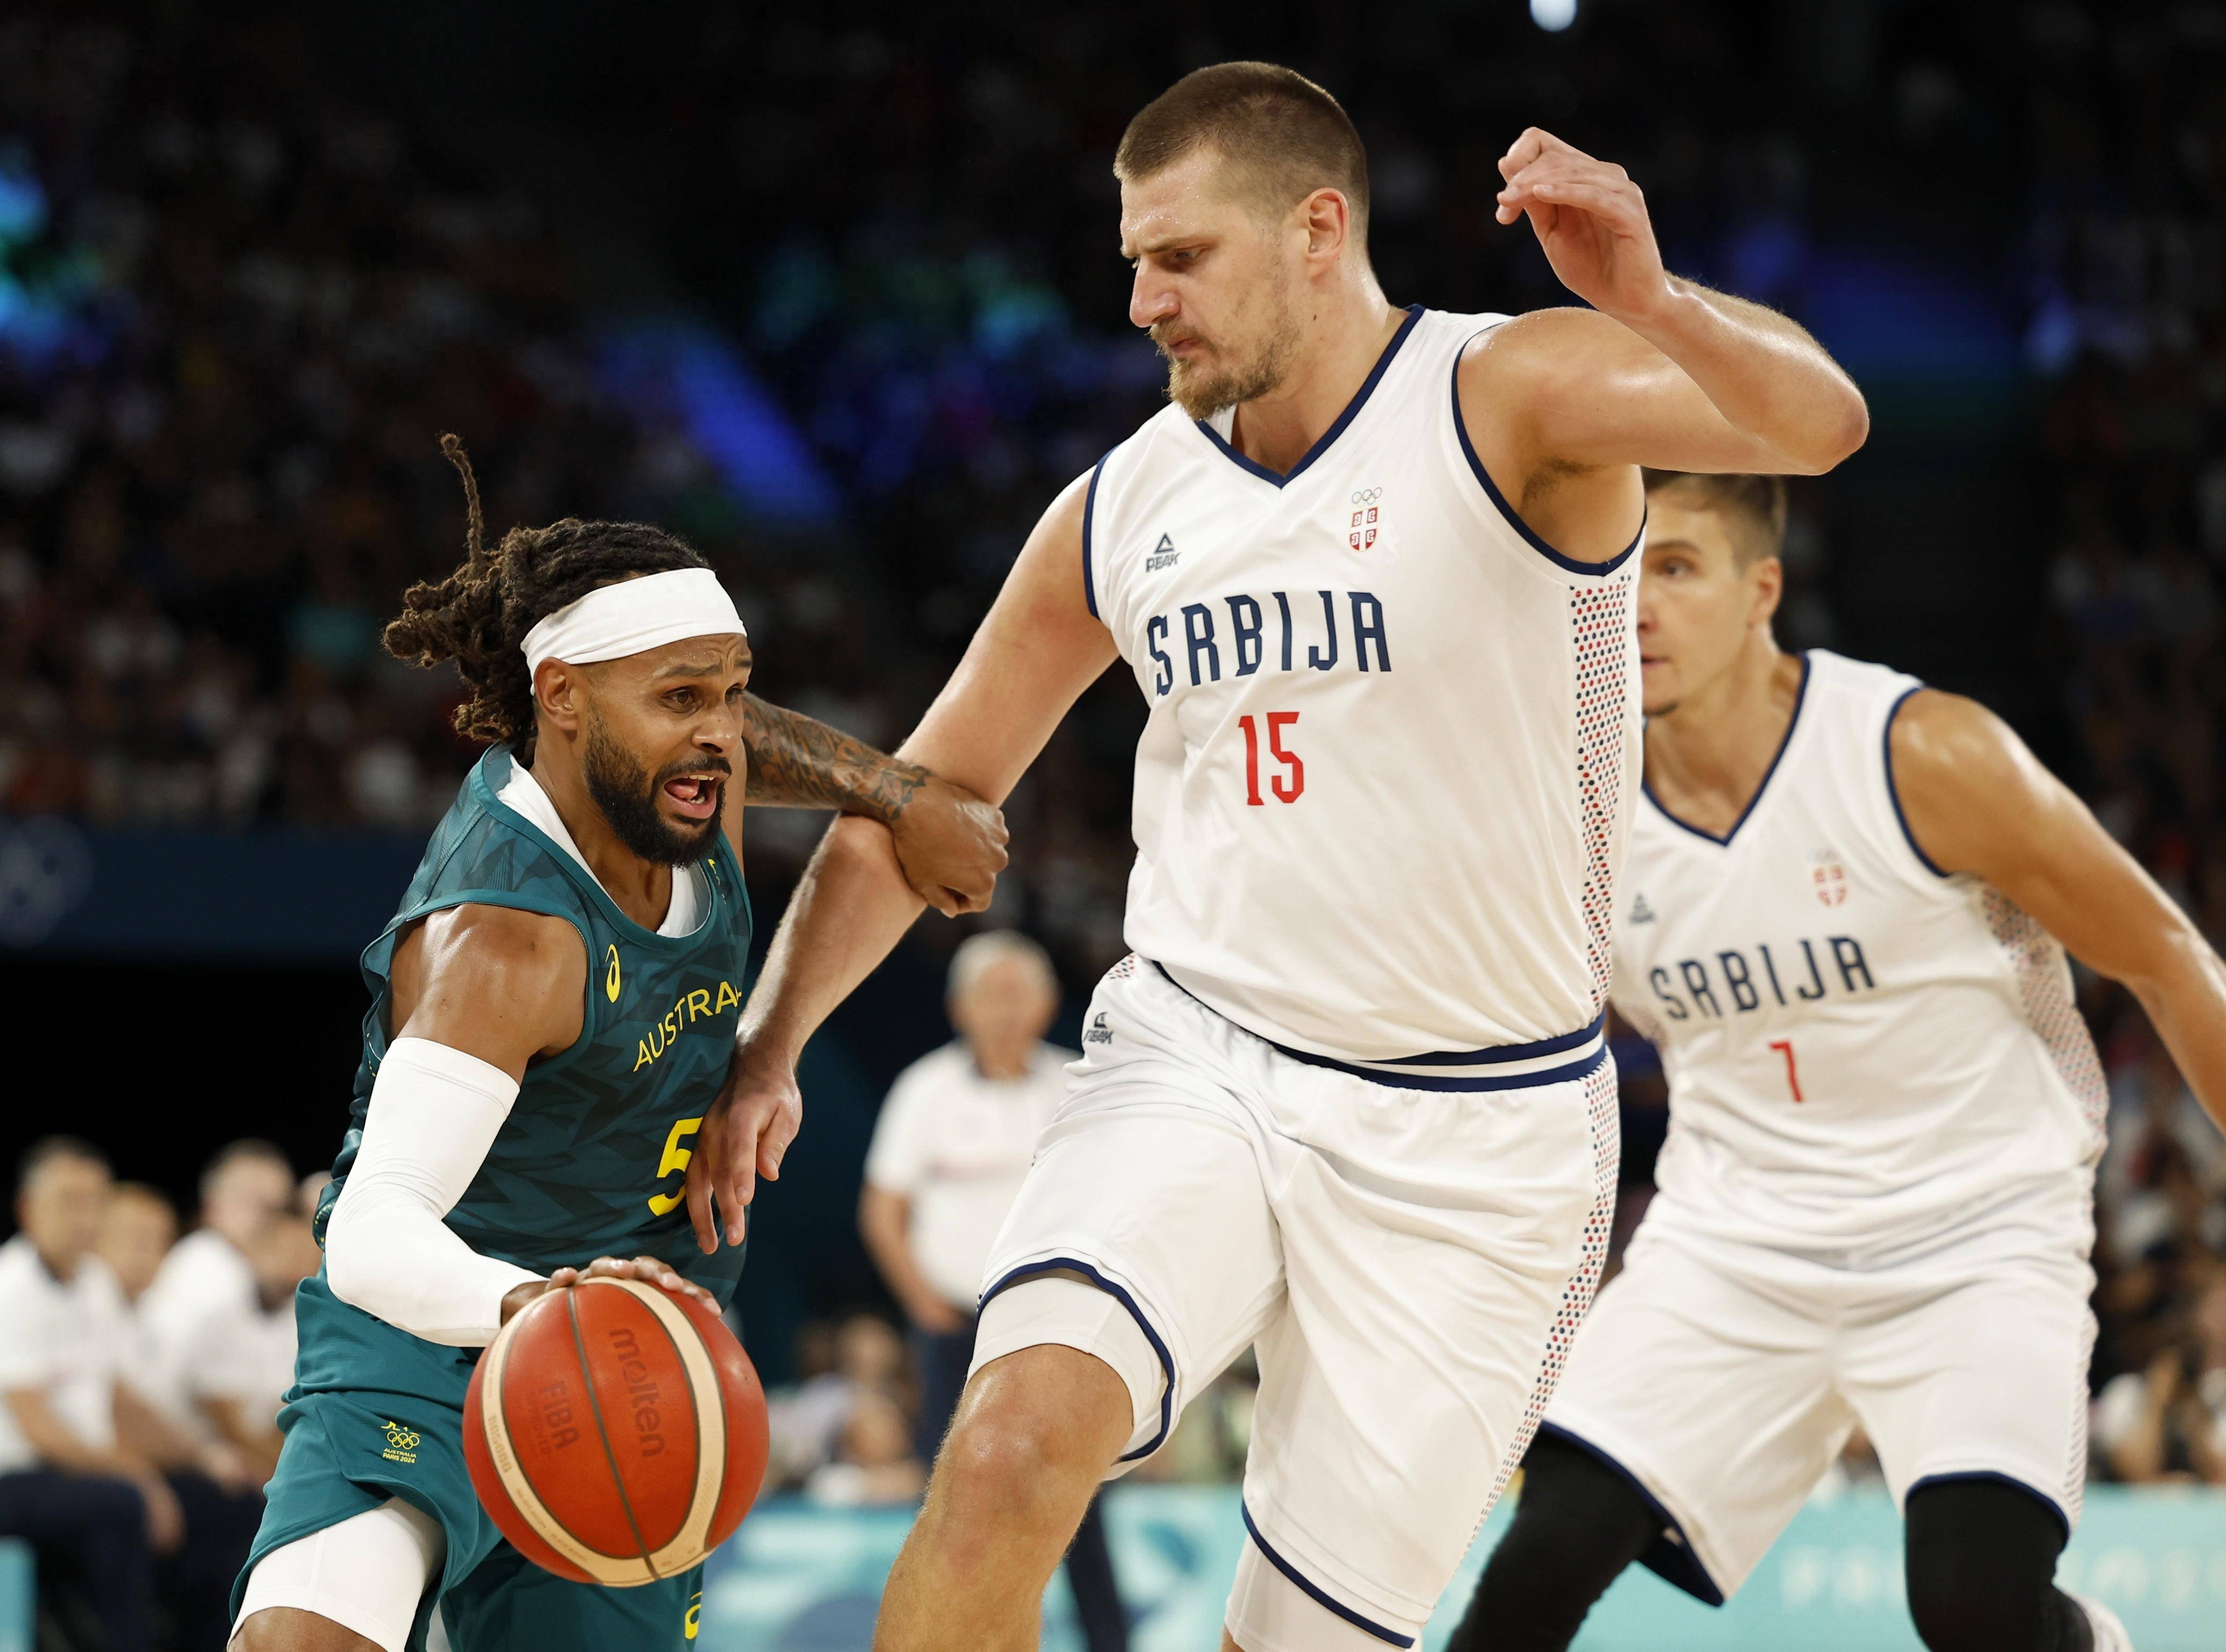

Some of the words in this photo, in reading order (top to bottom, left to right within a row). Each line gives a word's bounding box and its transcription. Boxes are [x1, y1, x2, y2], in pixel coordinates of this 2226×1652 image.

[1145, 552, 1181, 573] PEAK
[1147, 590, 1392, 696] SRBIJA
[1238, 711, 1304, 806] 15
[1650, 936, 1875, 1020] SRBIJA
[1769, 1038, 1804, 1103] 7
[648, 1117, 704, 1216] 5
[540, 1380, 579, 1450] FIBA
[609, 1328, 666, 1458] molten
[382, 1452, 400, 1461] PARIS
[383, 1448, 417, 1458] AUSTRALIA
